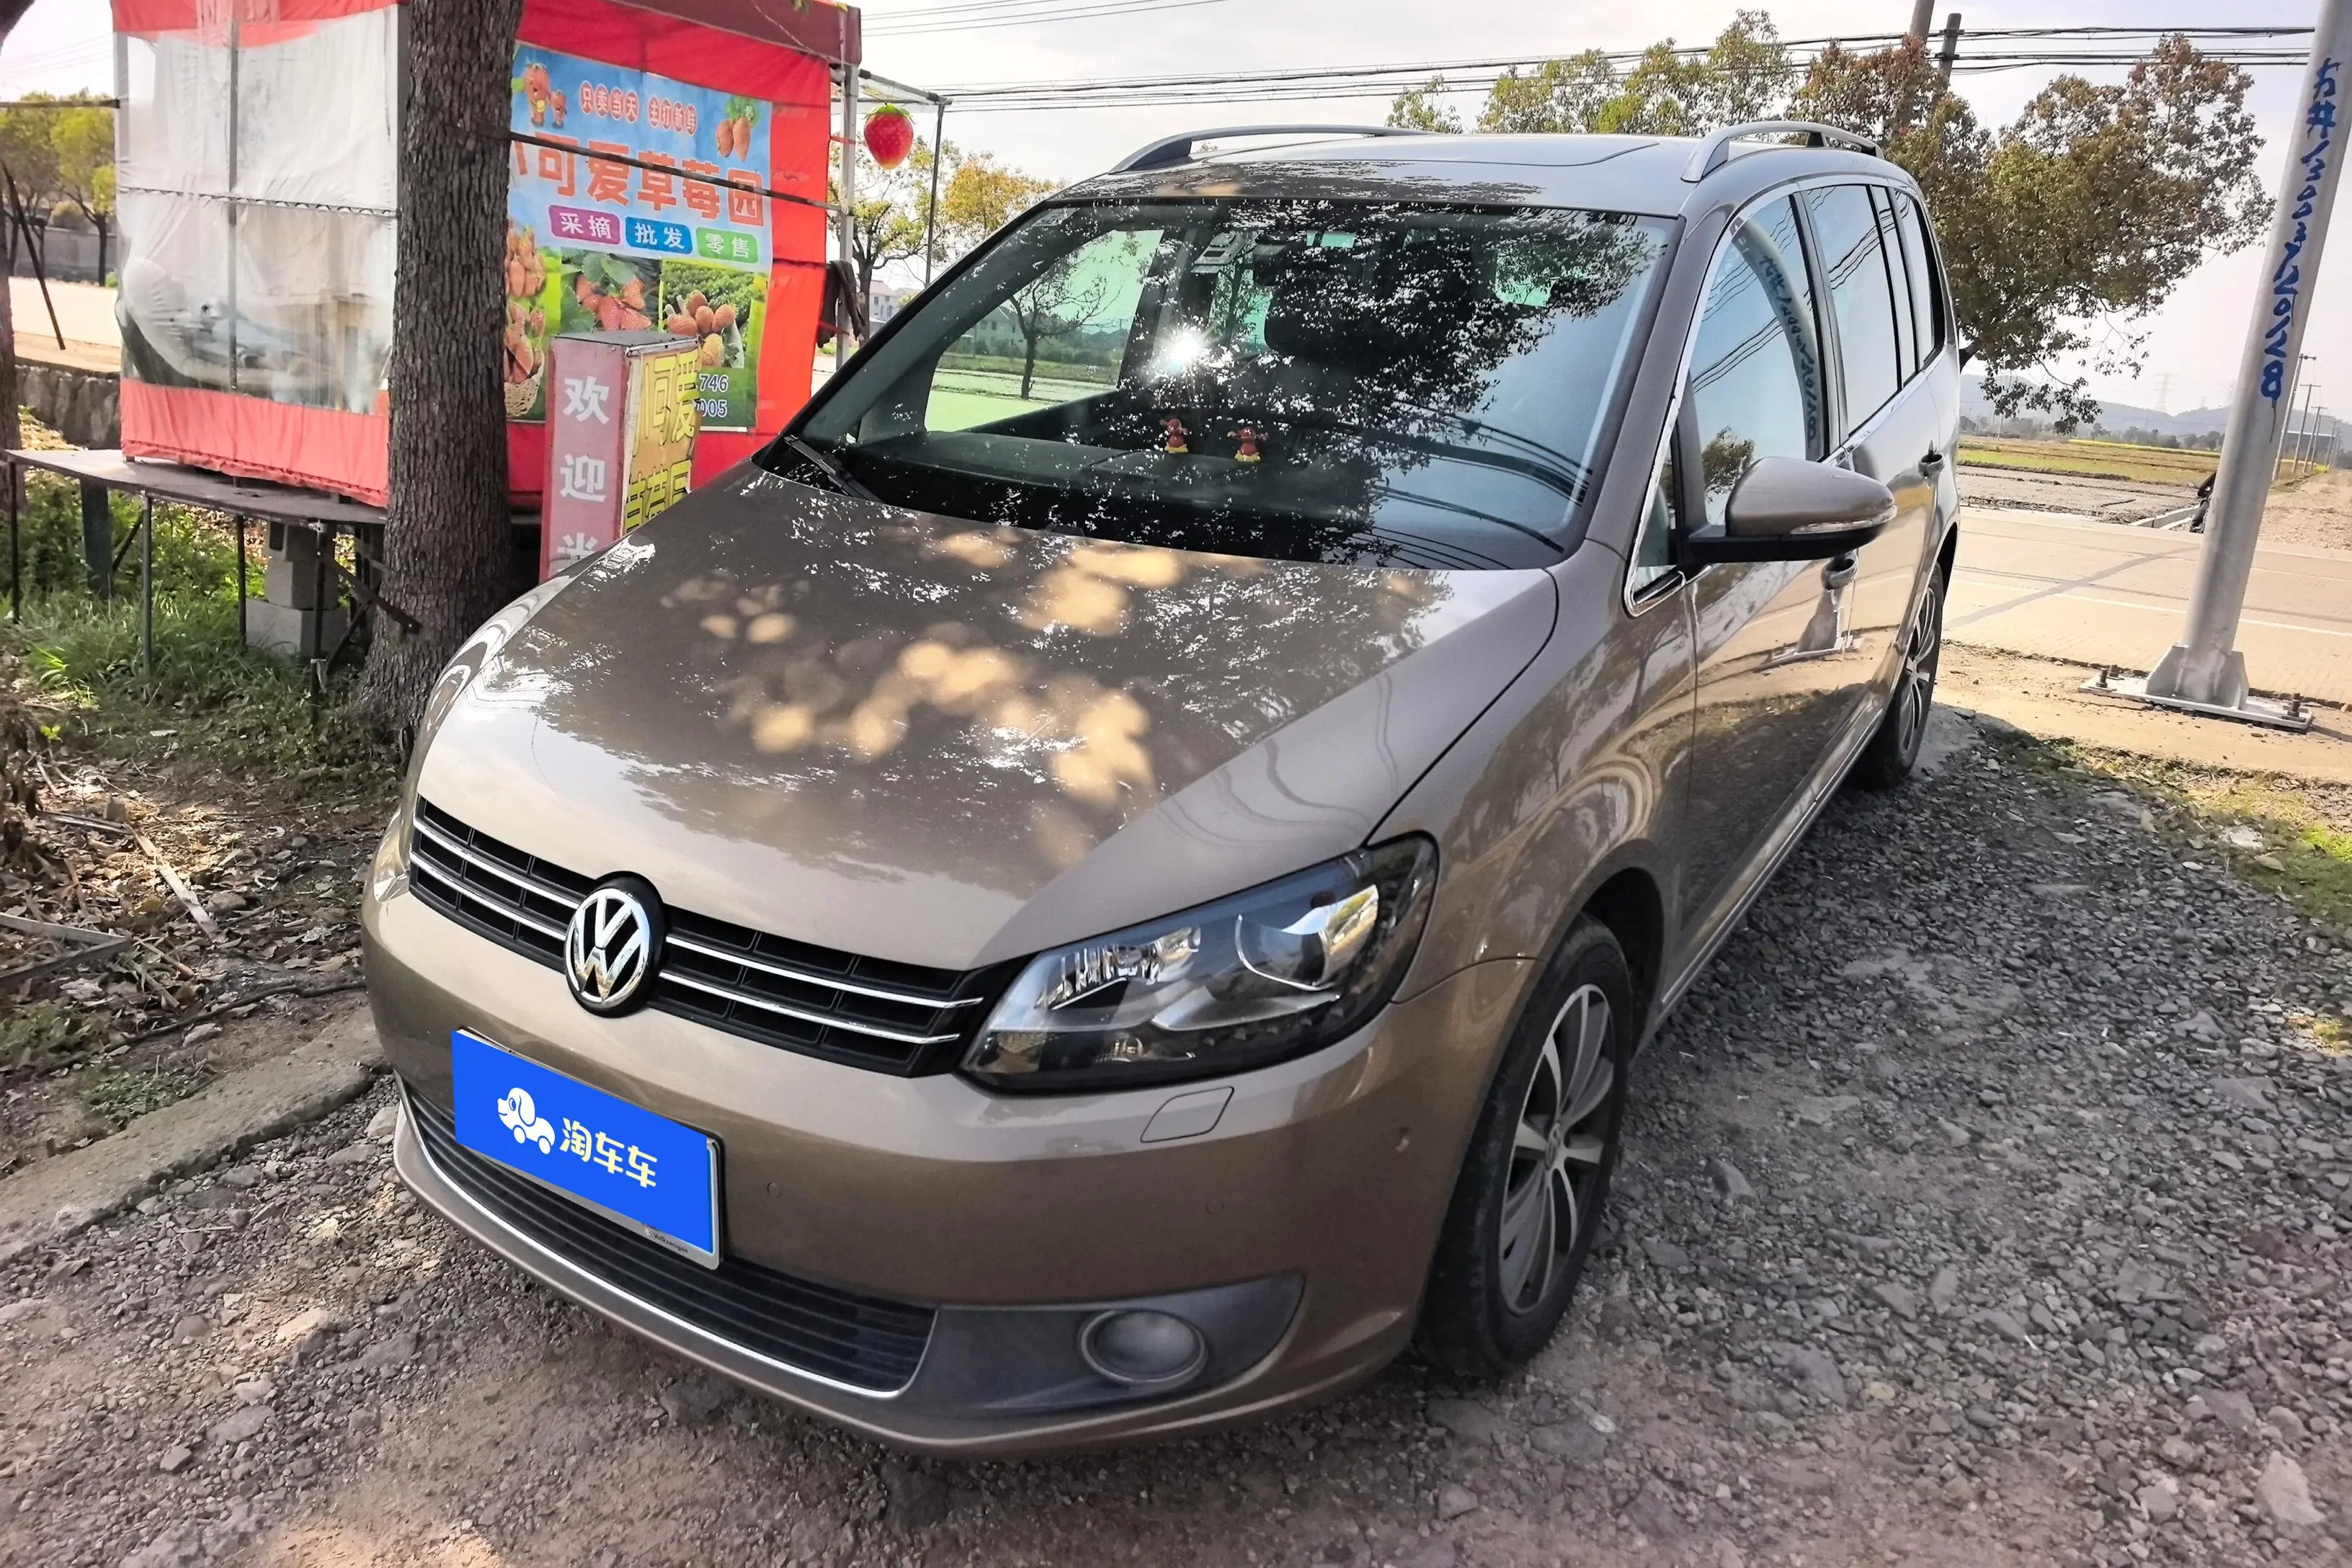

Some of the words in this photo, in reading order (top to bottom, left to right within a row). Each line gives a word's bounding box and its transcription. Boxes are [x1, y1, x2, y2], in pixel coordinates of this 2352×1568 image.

[581, 82, 638, 122] 只卖当天
[649, 97, 697, 134] 主打新鲜
[559, 213, 612, 239] 采摘
[635, 223, 685, 249] 批发
[705, 233, 750, 258] 零售
[700, 374, 729, 393] 746
